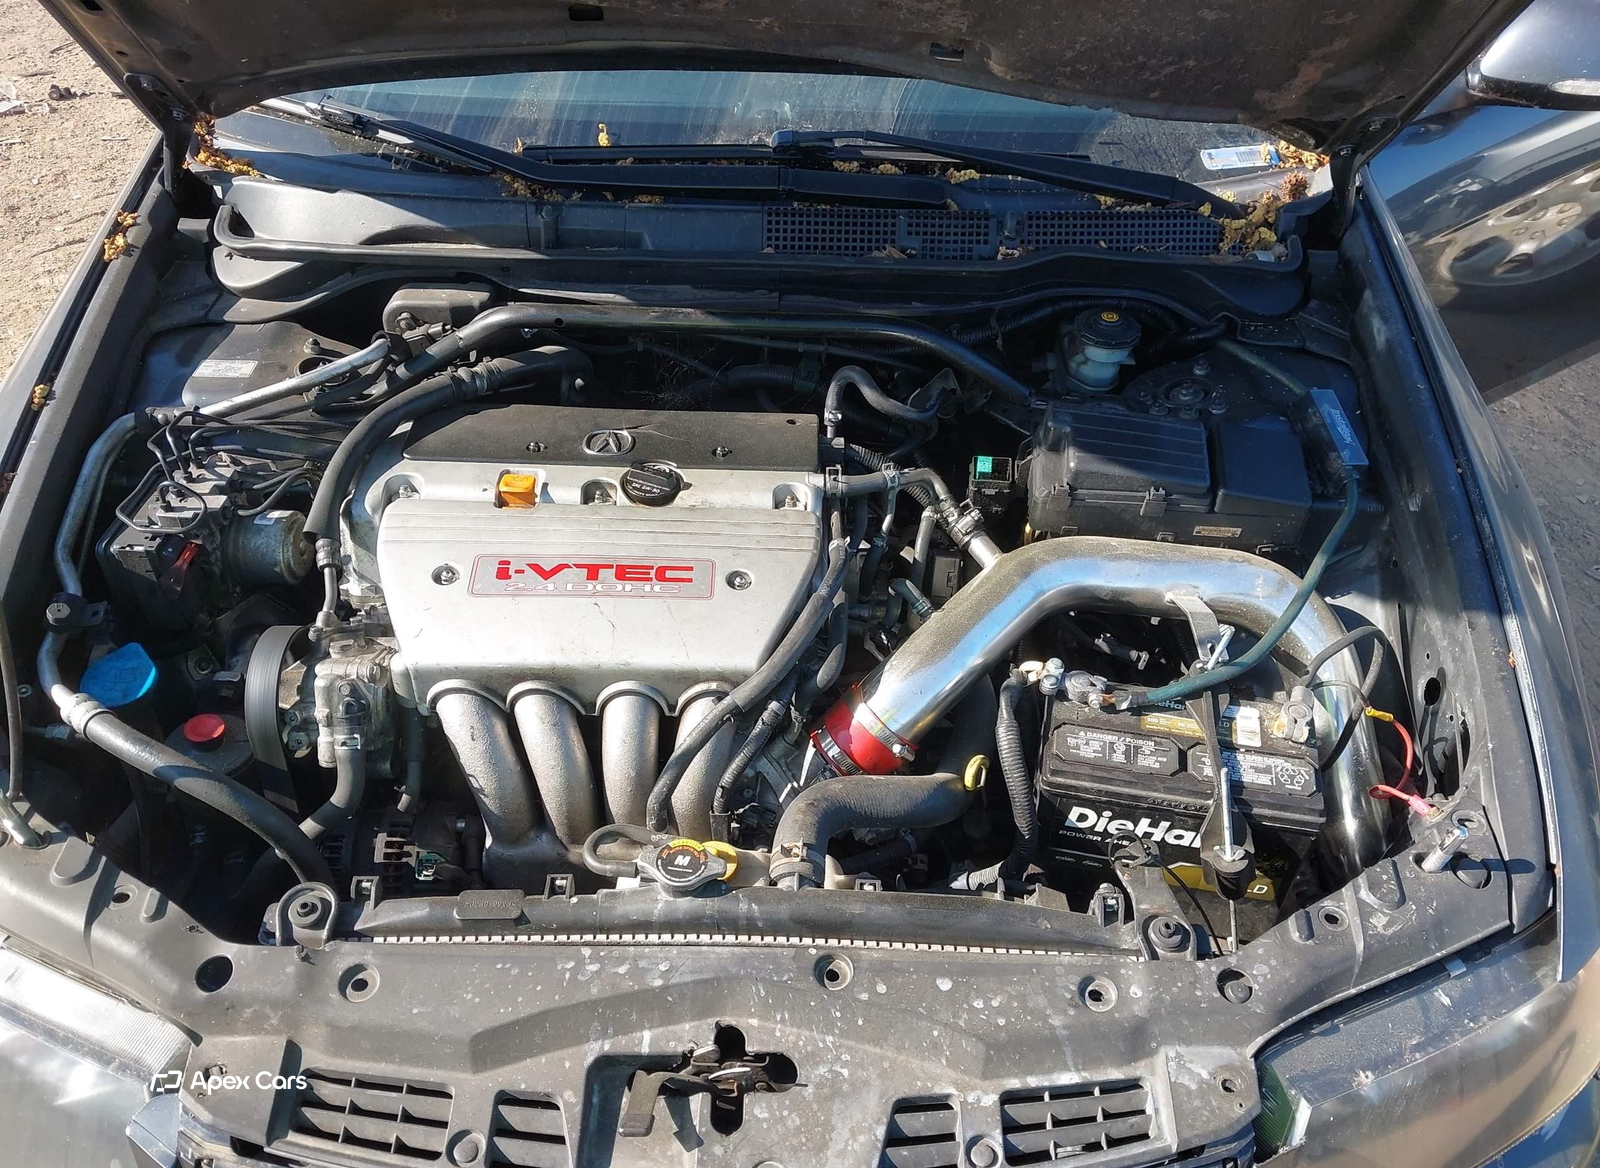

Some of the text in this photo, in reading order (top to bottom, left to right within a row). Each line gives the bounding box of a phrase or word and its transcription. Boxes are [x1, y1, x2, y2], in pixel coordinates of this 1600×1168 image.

[495, 560, 694, 583] i-VTEC
[504, 582, 682, 593] 2.4 DOHC
[1087, 731, 1118, 742] DANGER
[1126, 737, 1155, 747] POISON
[1064, 805, 1201, 849] DieHa
[1059, 829, 1102, 842] POWER
